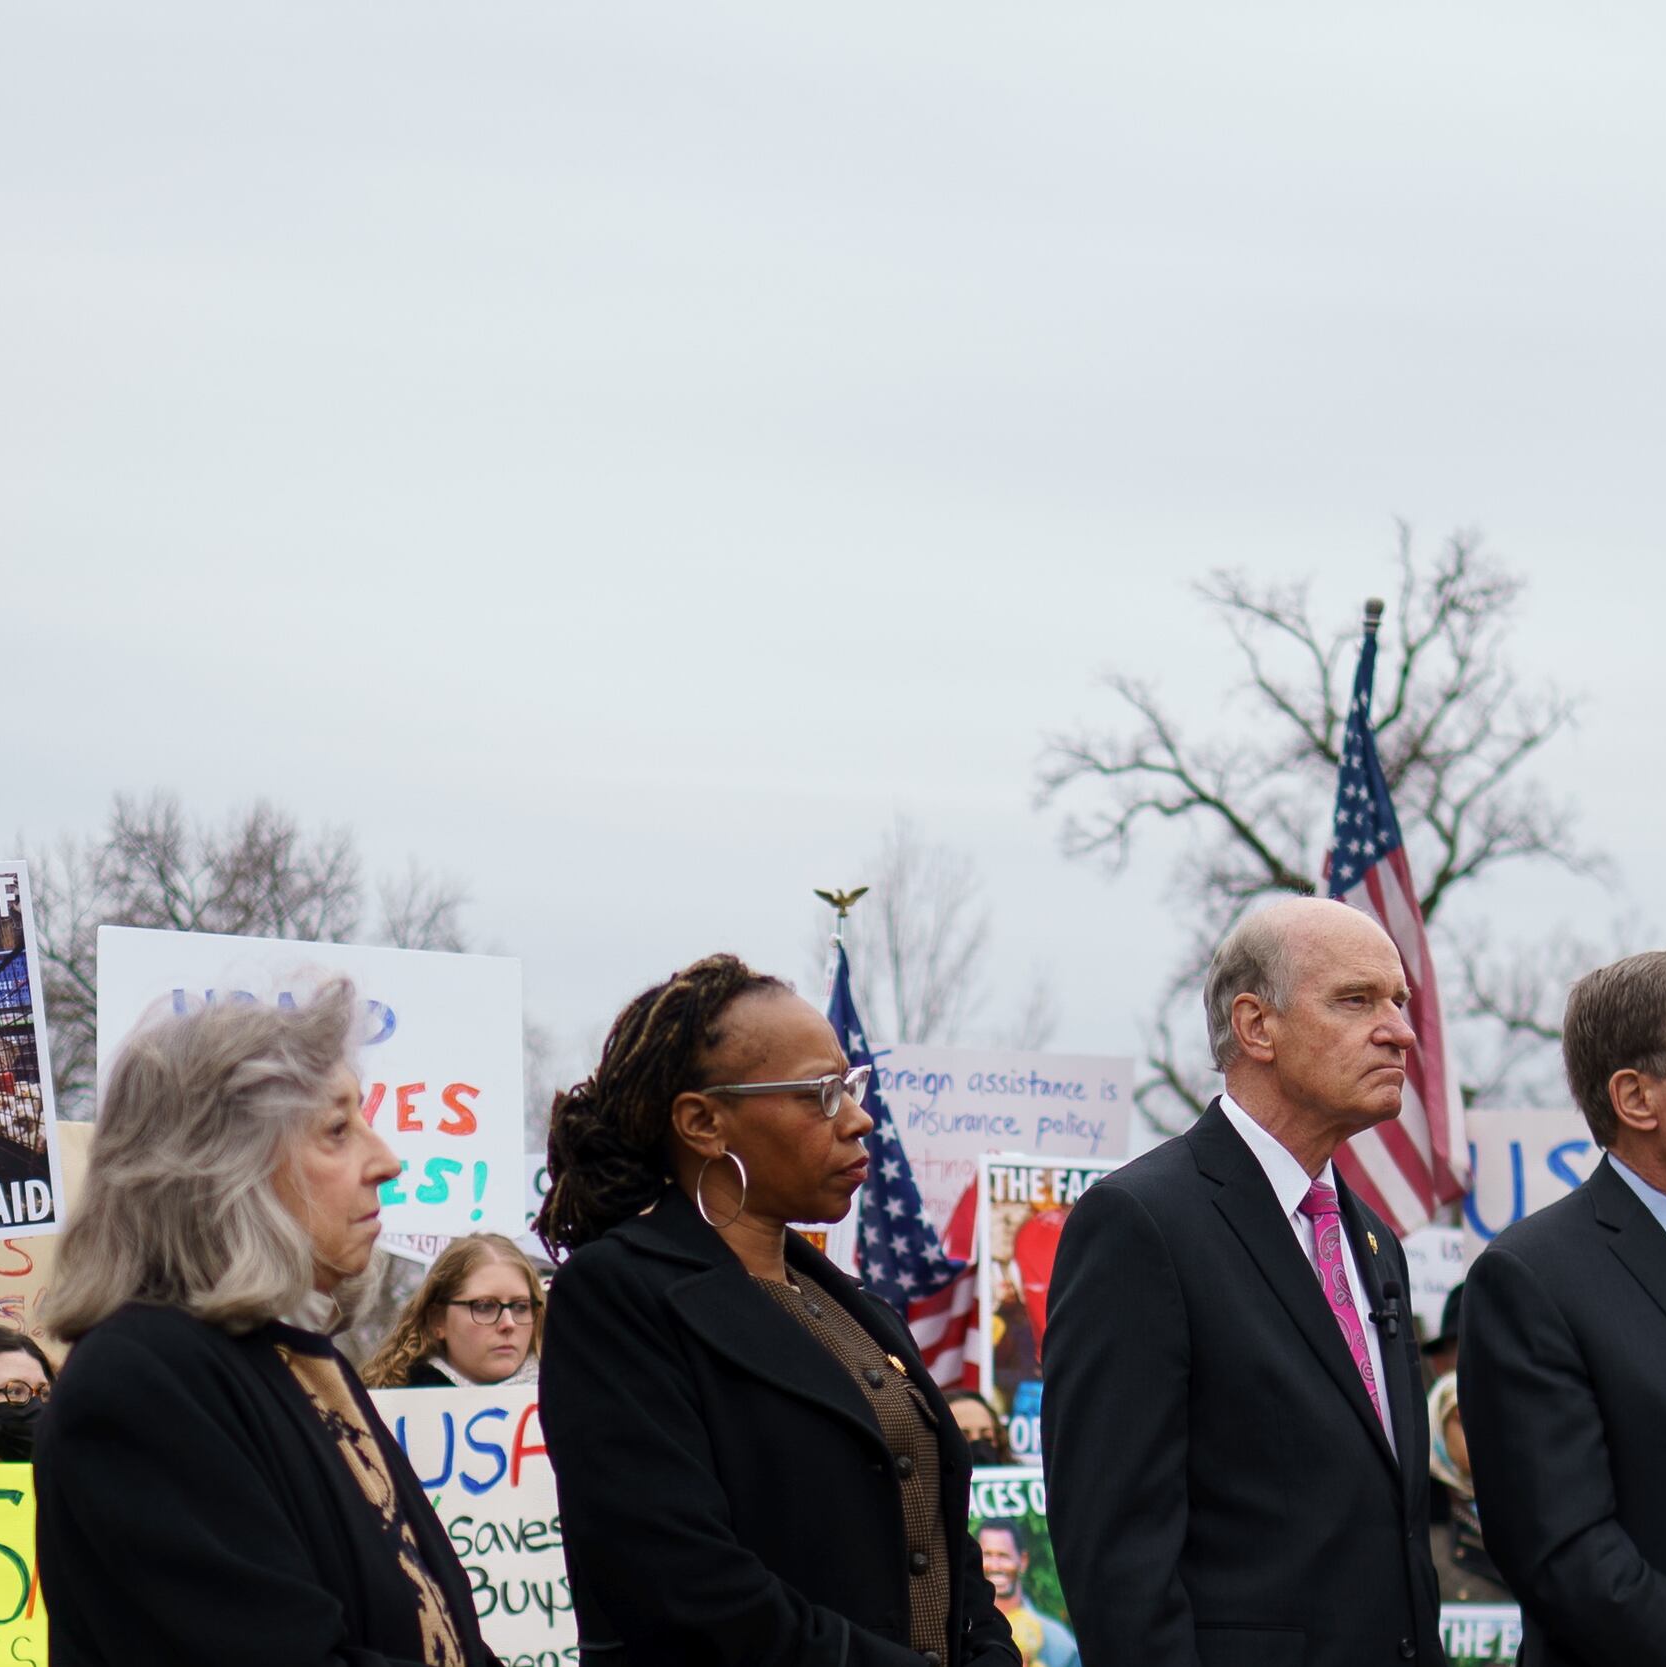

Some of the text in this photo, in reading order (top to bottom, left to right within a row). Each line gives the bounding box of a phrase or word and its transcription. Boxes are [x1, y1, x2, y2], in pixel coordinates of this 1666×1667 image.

[967, 1069, 1088, 1101] assistance
[1100, 1078, 1118, 1101] is
[990, 1166, 1046, 1204] THE
